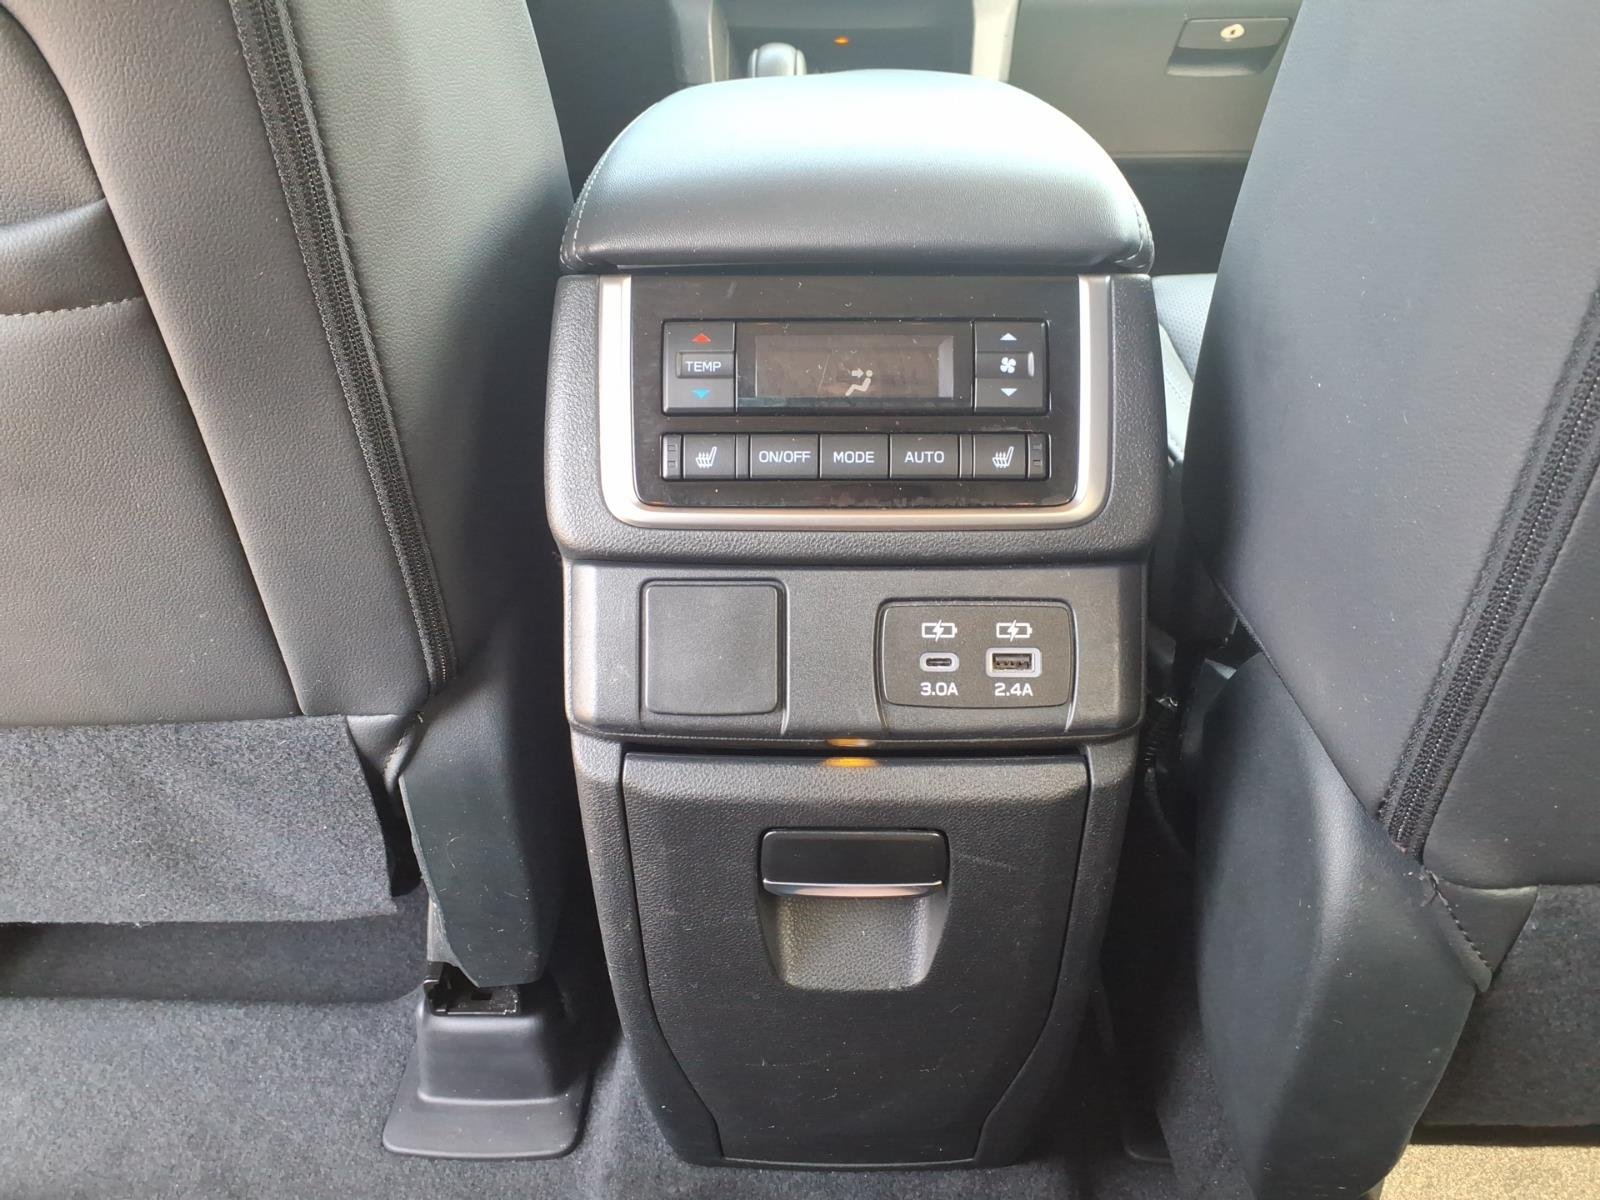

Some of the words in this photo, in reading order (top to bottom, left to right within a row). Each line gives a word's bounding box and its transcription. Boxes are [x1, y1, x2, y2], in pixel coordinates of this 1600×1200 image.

[685, 360, 722, 373] TEMP
[758, 451, 811, 464] ON/OFF
[833, 451, 875, 464] MODE
[903, 451, 945, 464] AUTO
[920, 682, 959, 696] 3.0A
[994, 682, 1034, 697] 2.4A
